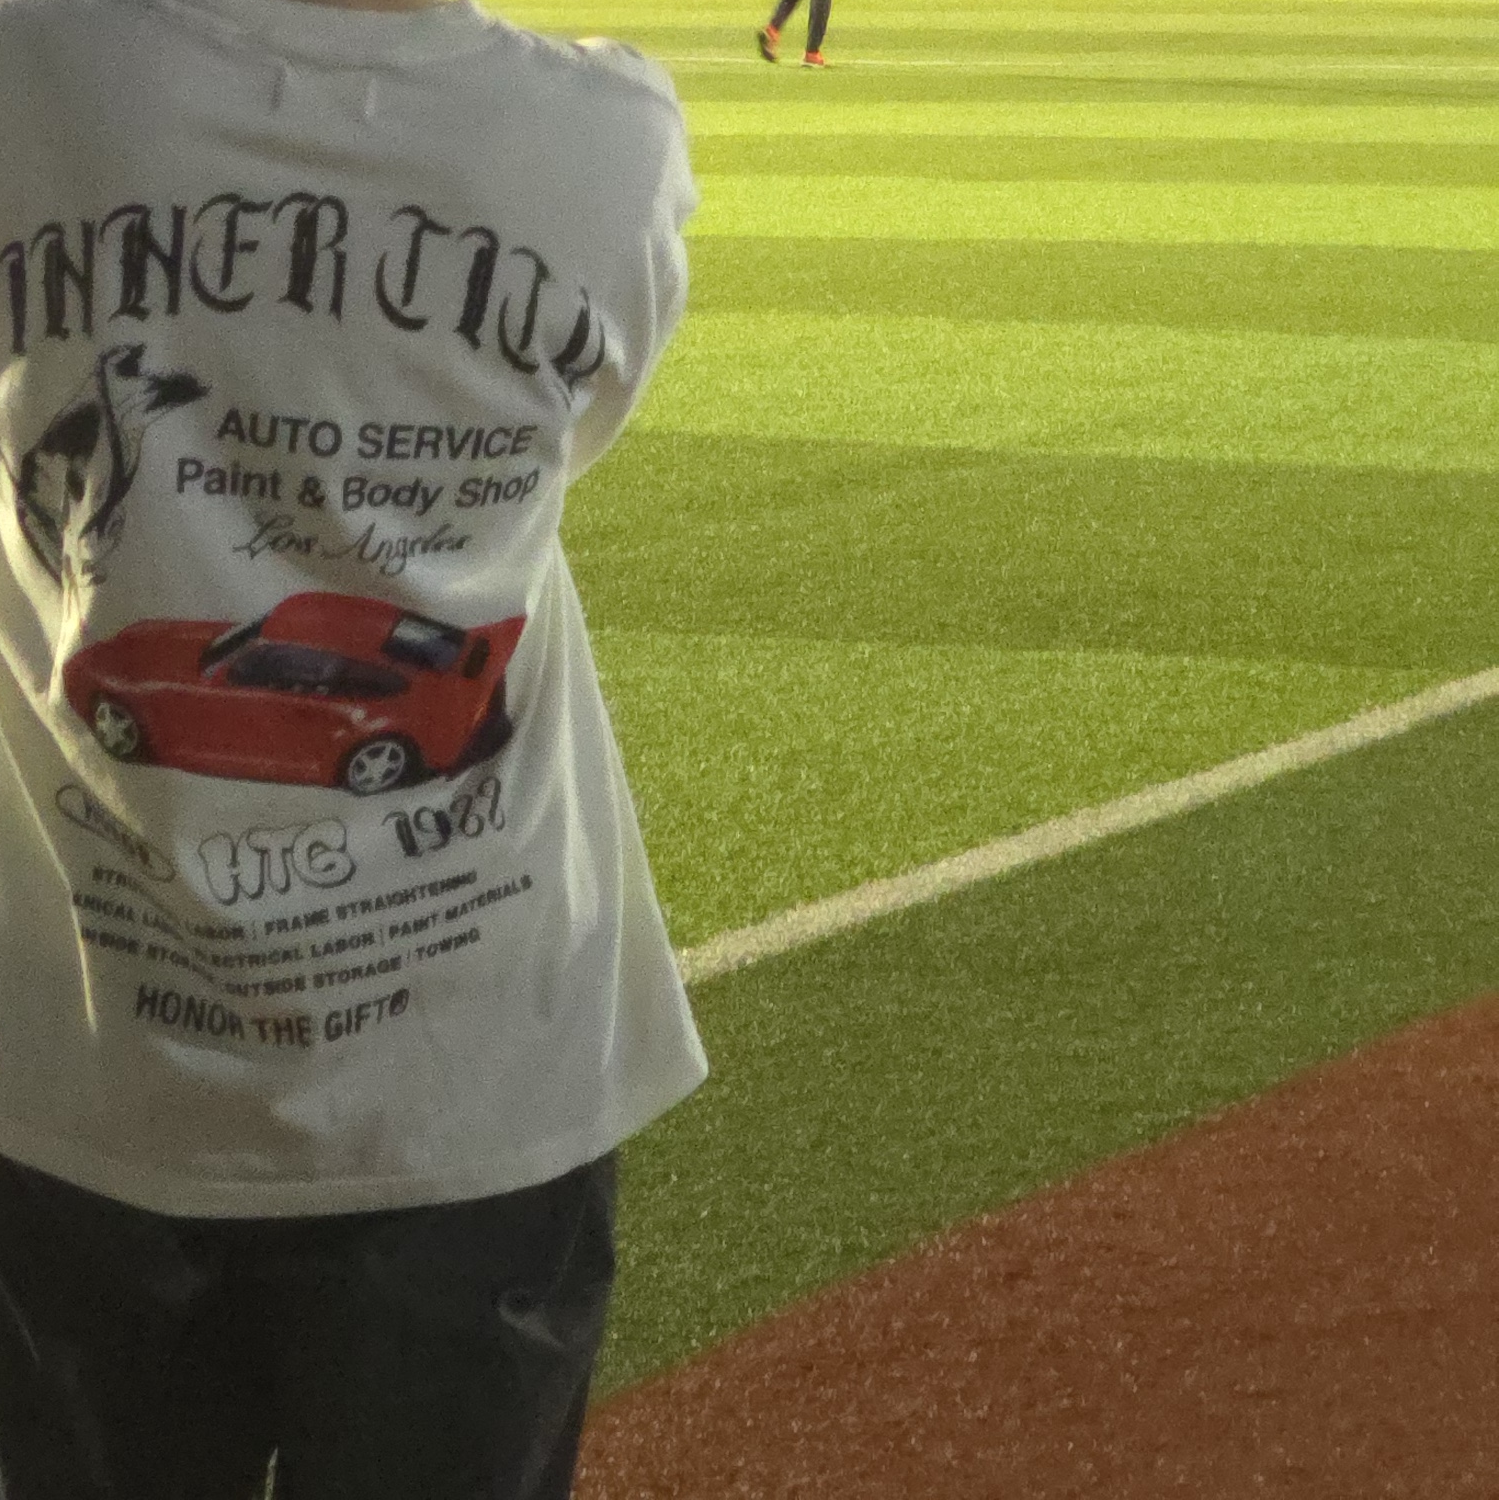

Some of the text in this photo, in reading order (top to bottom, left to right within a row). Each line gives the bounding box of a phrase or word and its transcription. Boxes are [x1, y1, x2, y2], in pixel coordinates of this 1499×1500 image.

[217, 407, 539, 461] AUTO SERVICE
[175, 456, 541, 517] Paint & Body Shop
[313, 954, 402, 990] STORAGE
[415, 926, 481, 961] TOWING
[250, 1014, 315, 1049] THE
